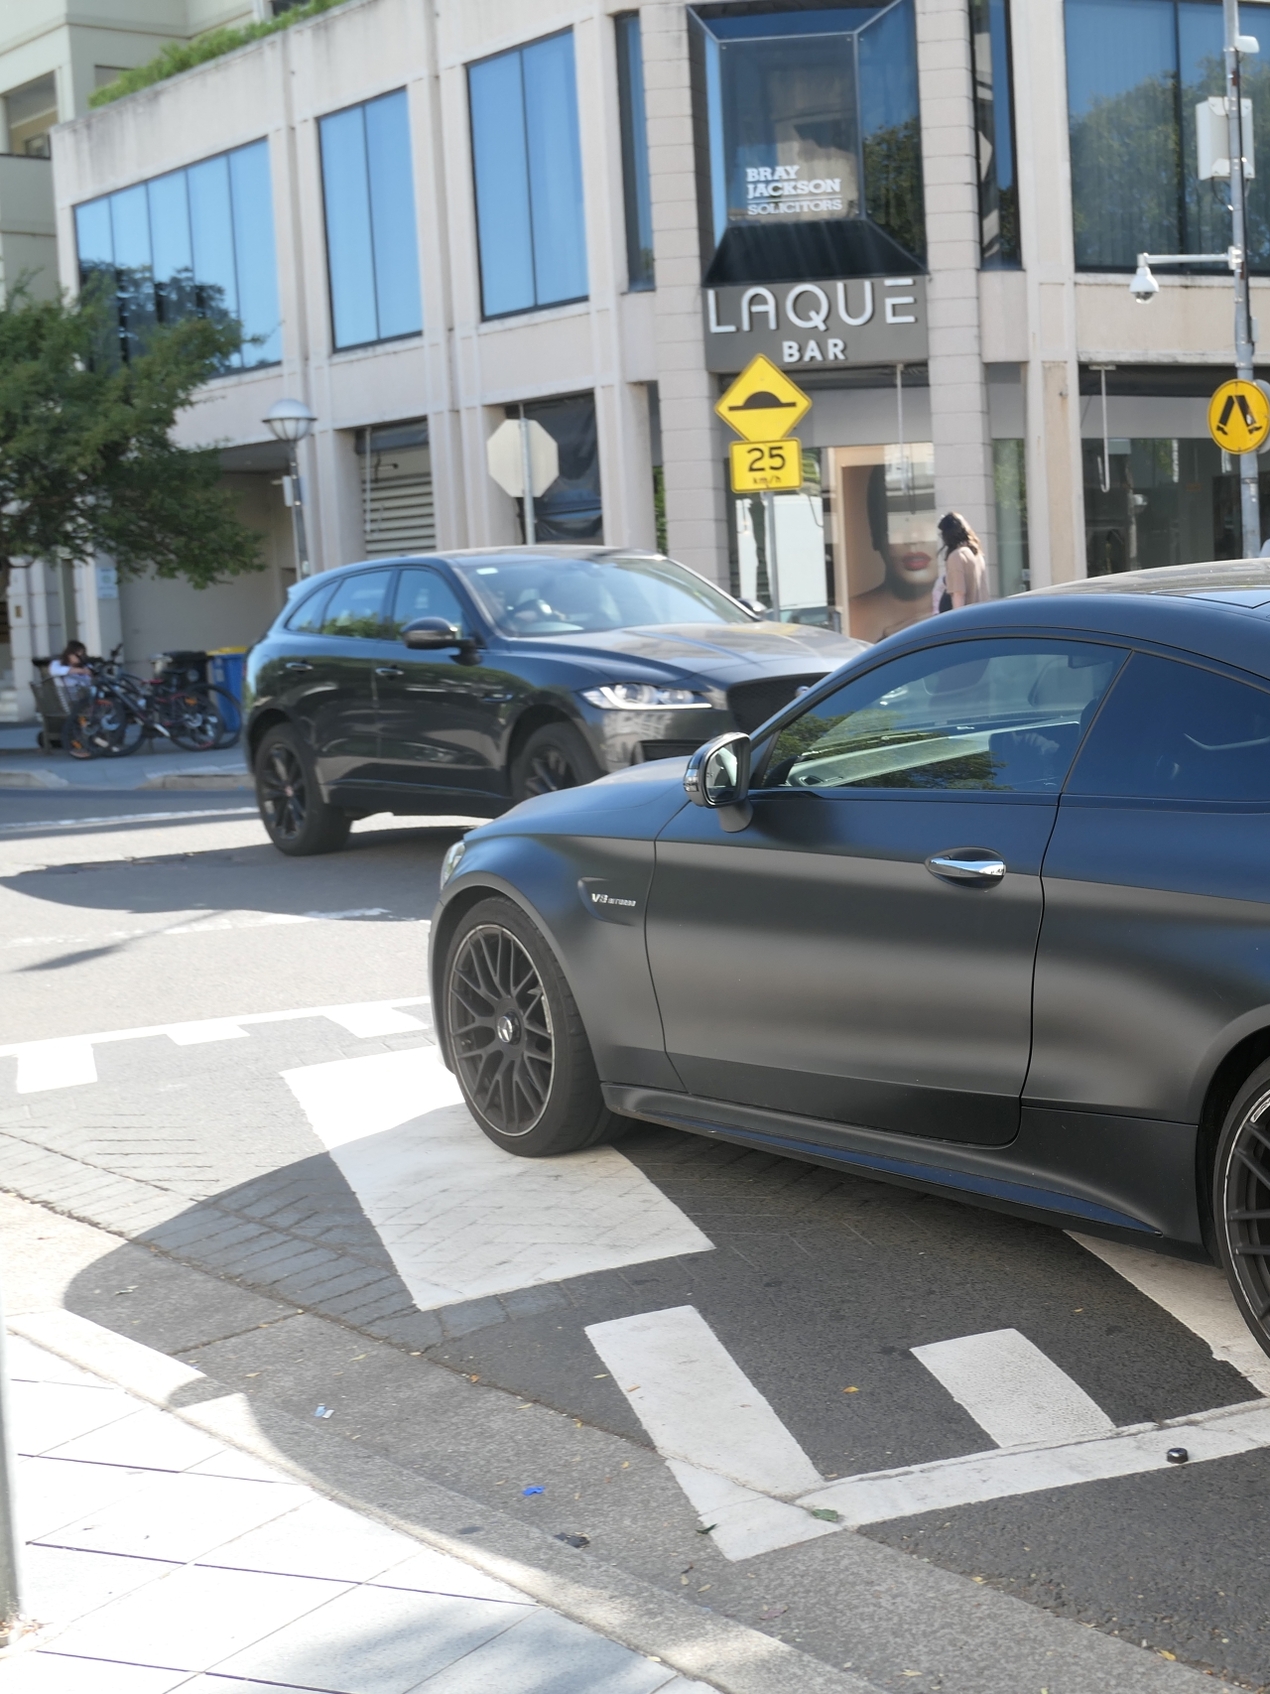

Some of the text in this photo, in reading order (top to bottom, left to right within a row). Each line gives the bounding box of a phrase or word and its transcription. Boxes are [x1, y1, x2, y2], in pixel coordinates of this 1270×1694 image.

[746, 165, 800, 182] BRAY
[746, 178, 842, 199] JACKSON
[747, 199, 843, 215] SOLICITORS
[707, 278, 916, 333] LAQUE
[782, 338, 846, 363] BAR
[747, 446, 786, 472] 25
[753, 475, 782, 484] km/h
[591, 893, 609, 903] V8
